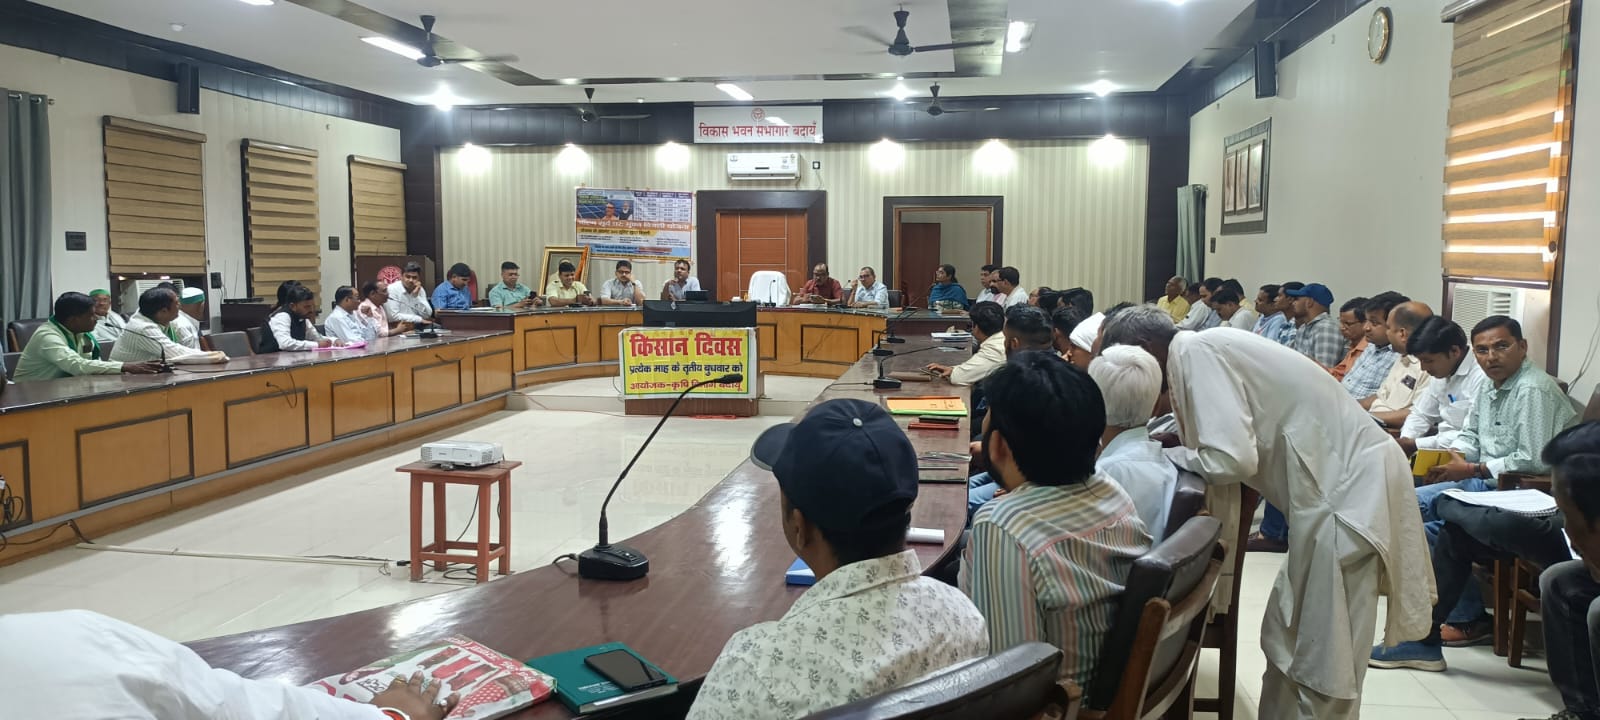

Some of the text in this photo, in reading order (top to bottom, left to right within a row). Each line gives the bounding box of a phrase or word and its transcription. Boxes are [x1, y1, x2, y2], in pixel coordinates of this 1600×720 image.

[699, 122, 729, 137] विकास
[732, 125, 753, 137] भवन
[756, 125, 791, 137] सभागार
[694, 332, 742, 356] दिवस
[629, 361, 743, 376] प्रत्येक माह के तृतीय बुधवार को
